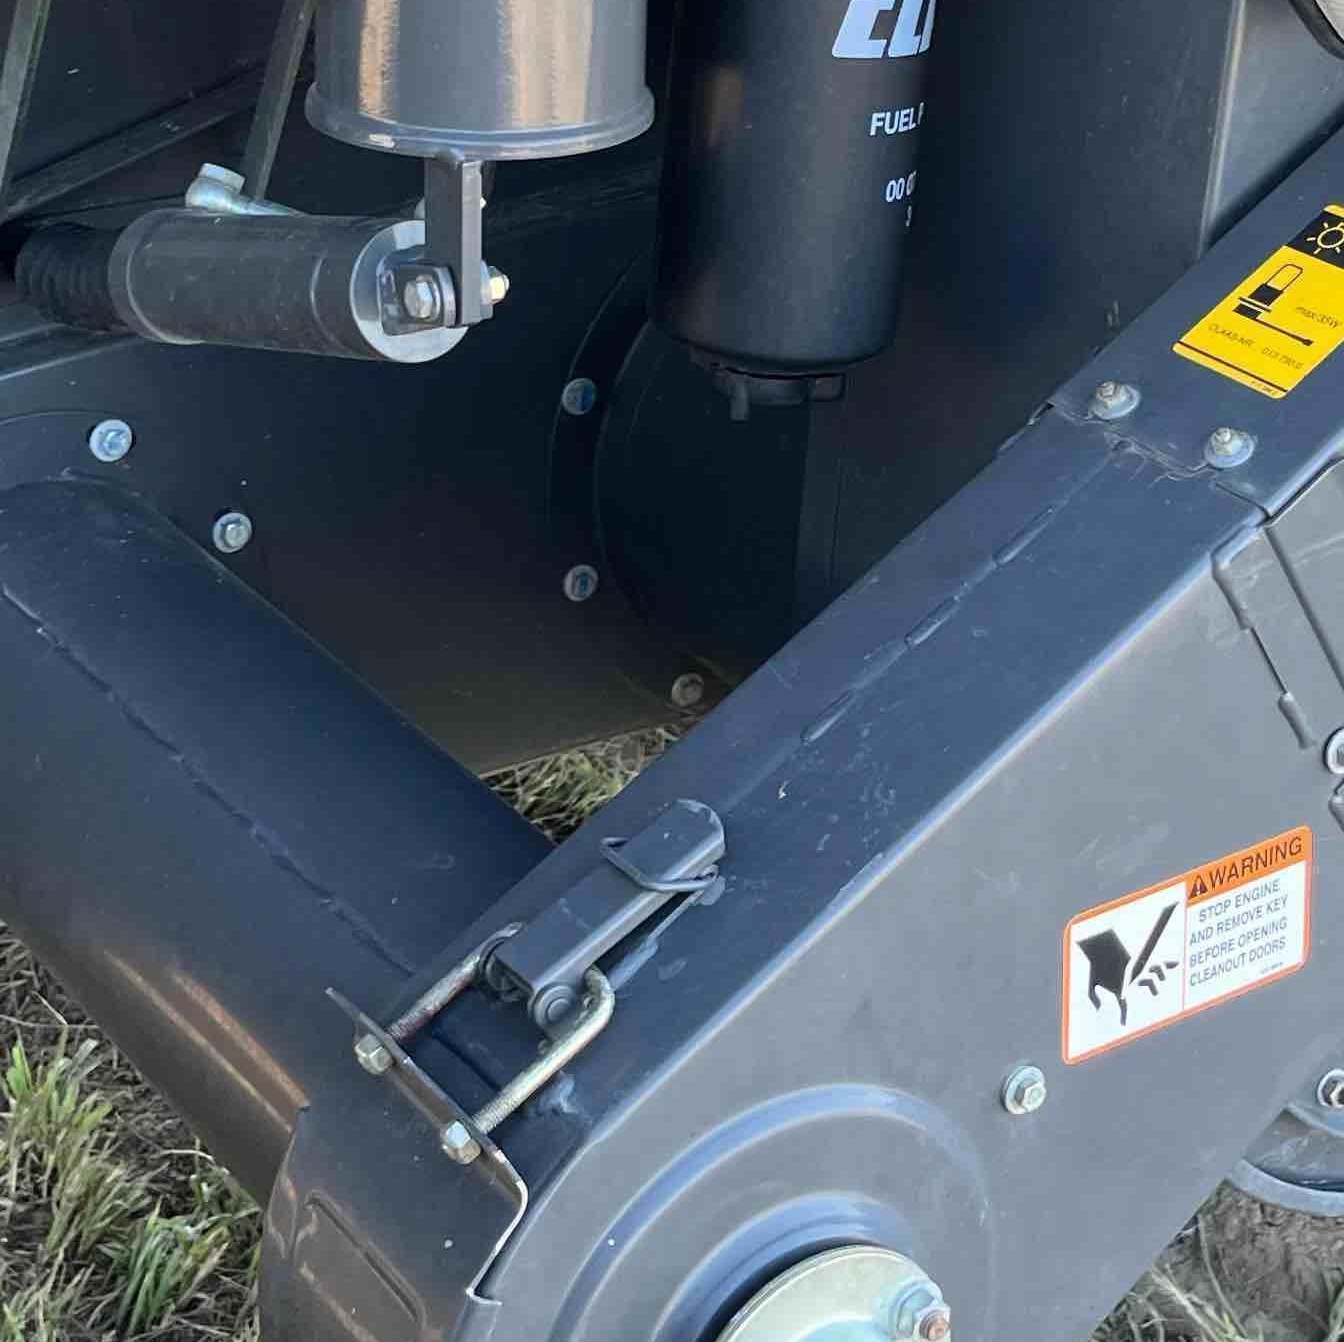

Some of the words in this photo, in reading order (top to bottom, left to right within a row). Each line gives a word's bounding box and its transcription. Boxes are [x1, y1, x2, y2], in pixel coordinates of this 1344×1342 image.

[869, 107, 917, 137] FUEL
[1209, 836, 1302, 890] WARNING
[1189, 926, 1213, 946] AND
[1216, 905, 1262, 936] REMOVE
[1266, 894, 1288, 916] KEY
[1198, 899, 1231, 923] STOP
[1235, 878, 1280, 909] ENGINE
[1189, 938, 1235, 968] BEFORE
[1237, 916, 1288, 948] OPENING
[1189, 952, 1246, 987] CLEANOUT
[1248, 937, 1286, 963] DOORS
